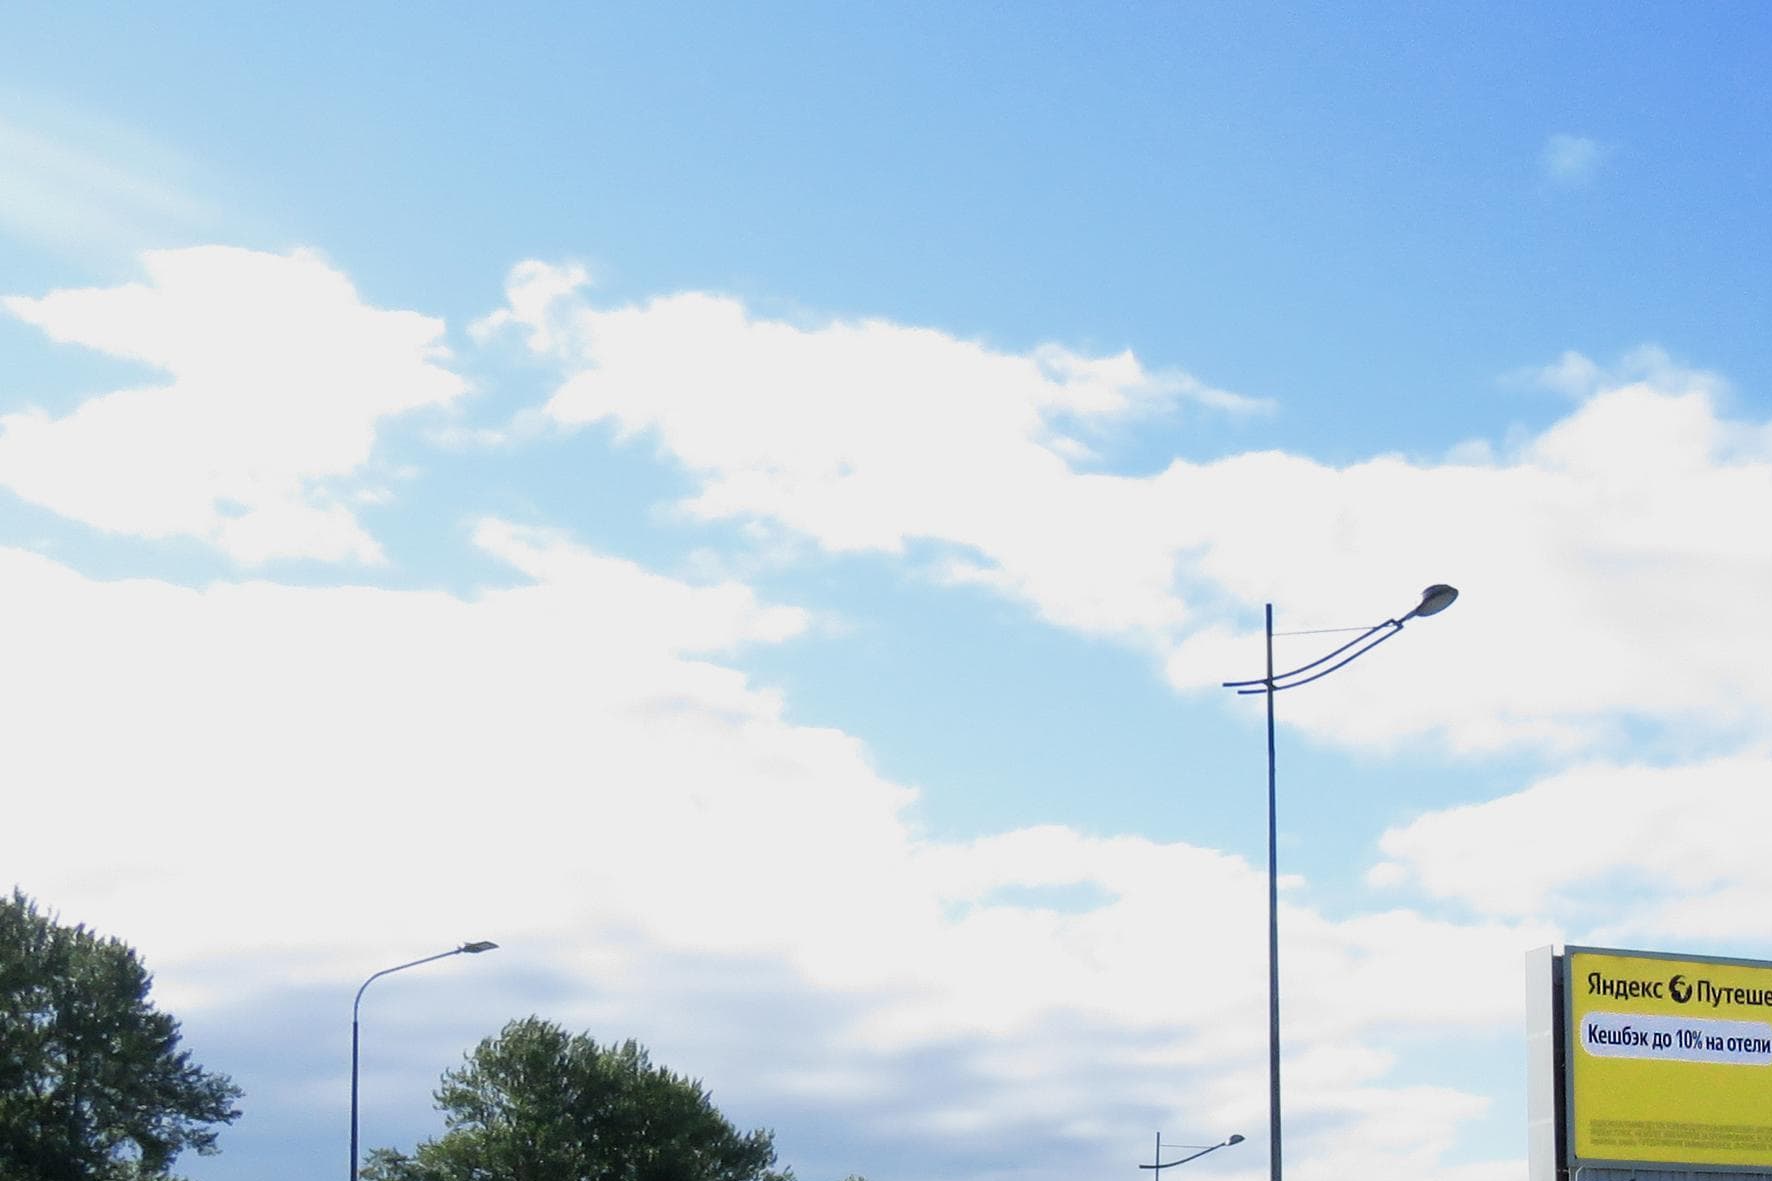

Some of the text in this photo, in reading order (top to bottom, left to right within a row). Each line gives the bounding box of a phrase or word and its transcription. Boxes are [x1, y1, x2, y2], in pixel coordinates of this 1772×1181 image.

[1588, 972, 1663, 1000] Яндекс
[1588, 1023, 1771, 1053] Кешбэк до 10% на отели
